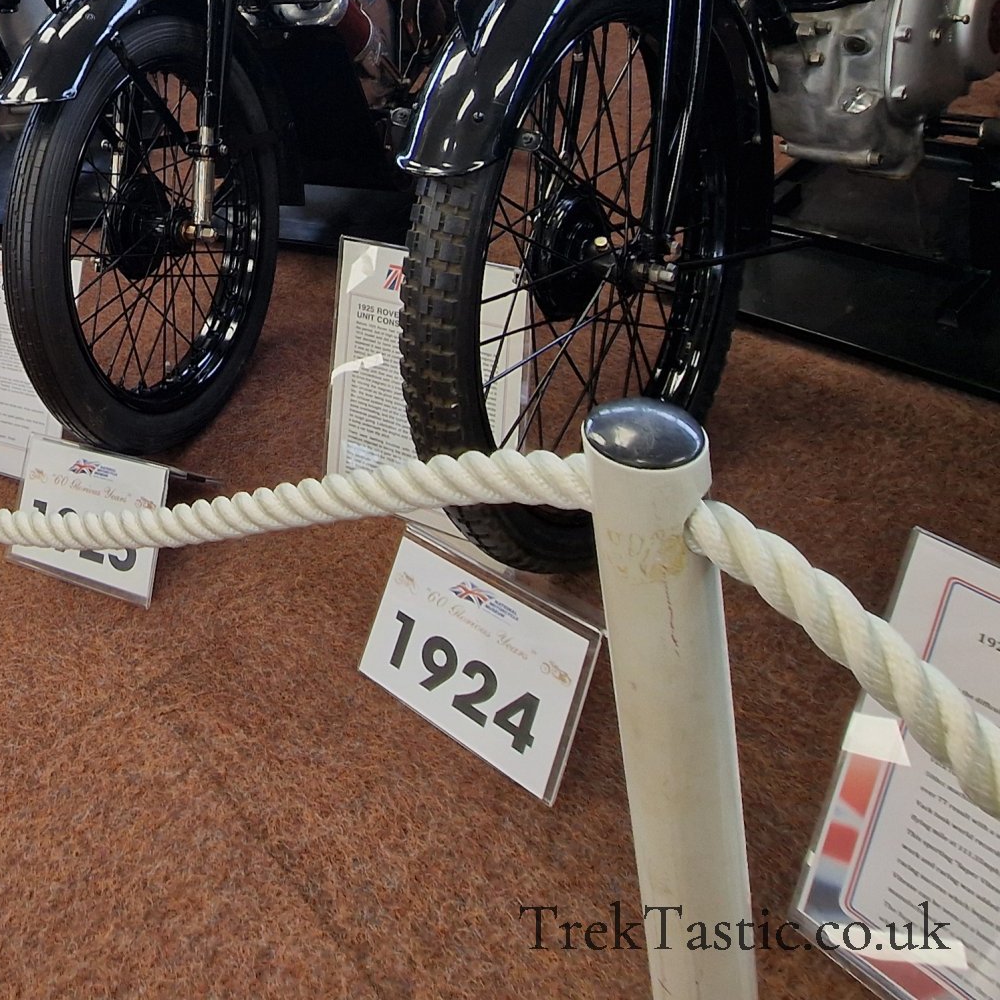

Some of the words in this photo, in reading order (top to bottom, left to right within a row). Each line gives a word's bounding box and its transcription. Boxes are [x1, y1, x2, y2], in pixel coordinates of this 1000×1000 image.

[358, 303, 375, 313] 1925
[356, 311, 375, 321] UNIT
[376, 316, 400, 327] CONS
[389, 610, 540, 755] 1924
